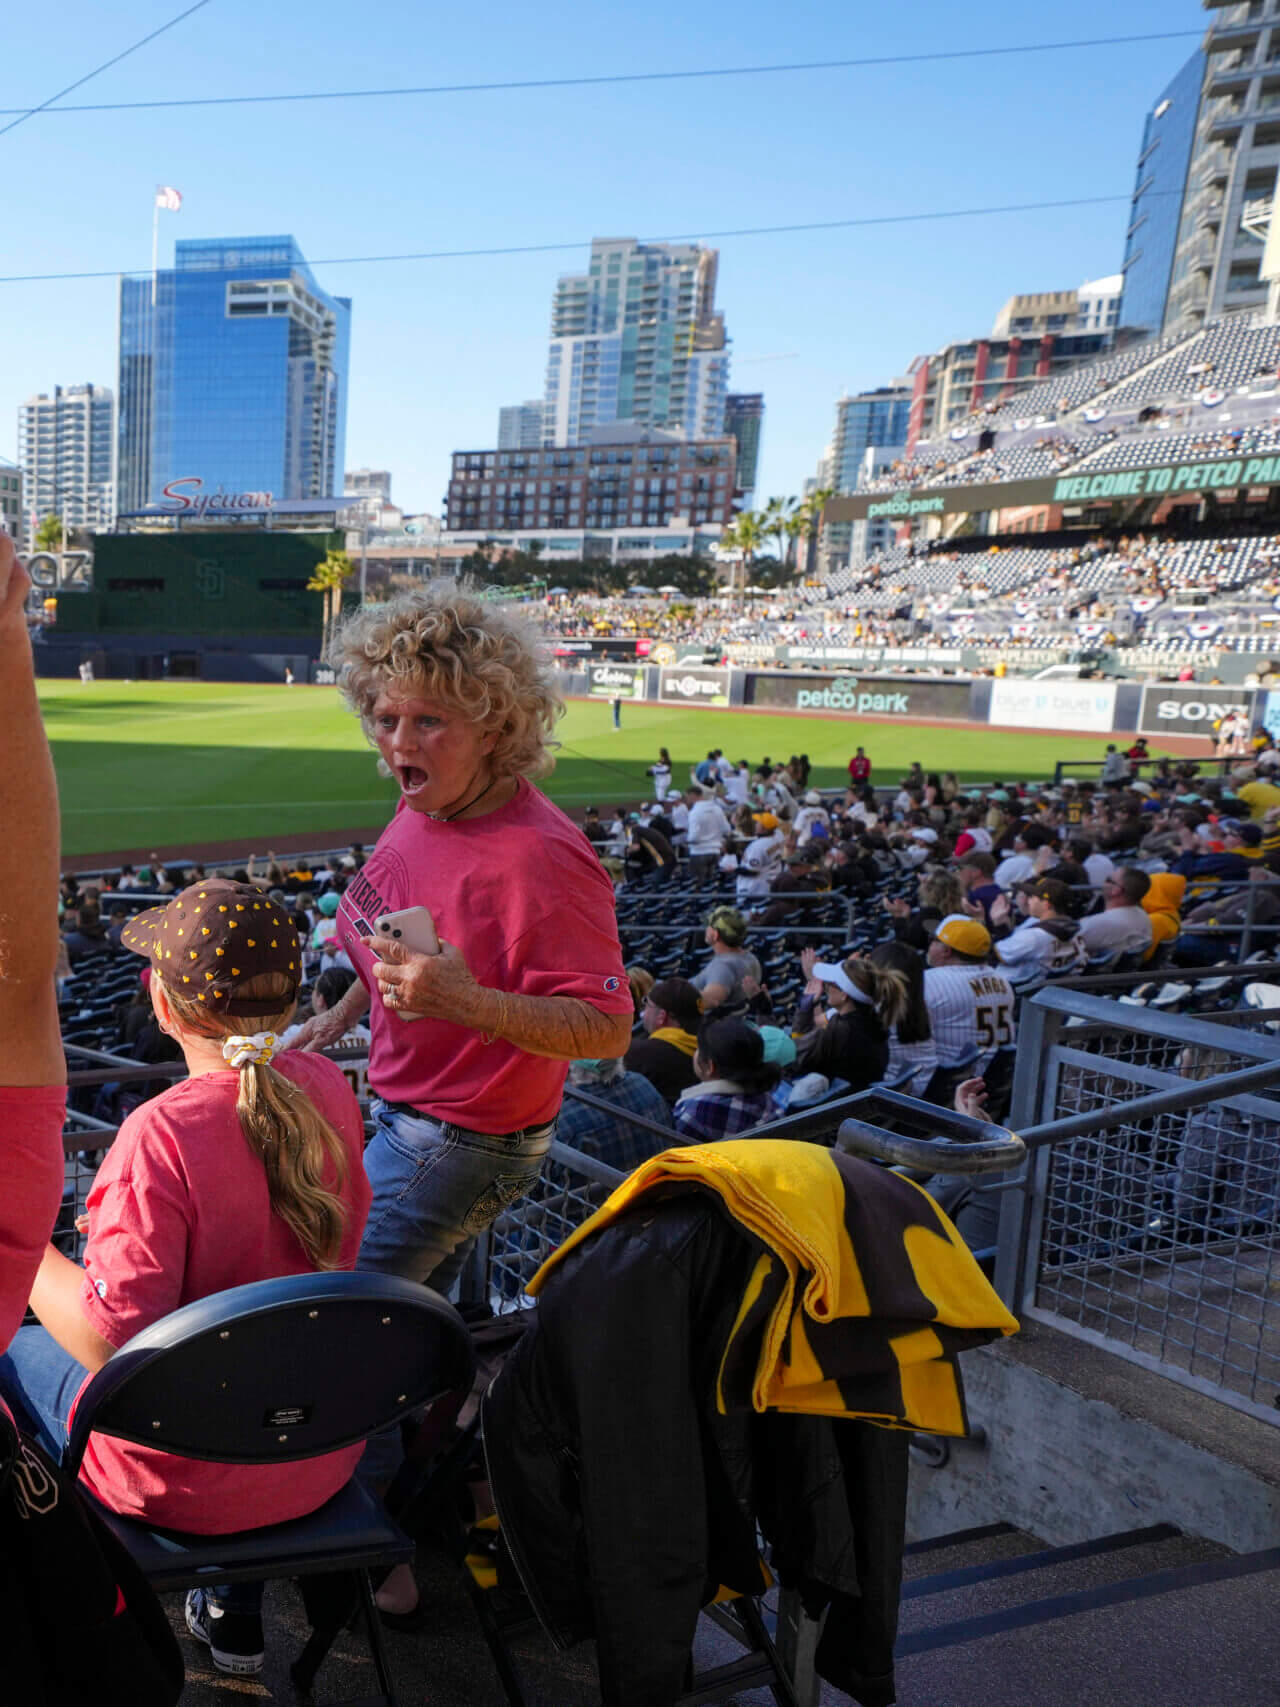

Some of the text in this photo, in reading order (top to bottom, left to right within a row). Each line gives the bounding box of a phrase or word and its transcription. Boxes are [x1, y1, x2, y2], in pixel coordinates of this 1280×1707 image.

[161, 478, 273, 518] Sycuan
[1054, 456, 1280, 501] WELCOME TO PETCO PA
[867, 495, 945, 518] petco park
[797, 689, 909, 715] petco park
[975, 1005, 1012, 1048] 55
